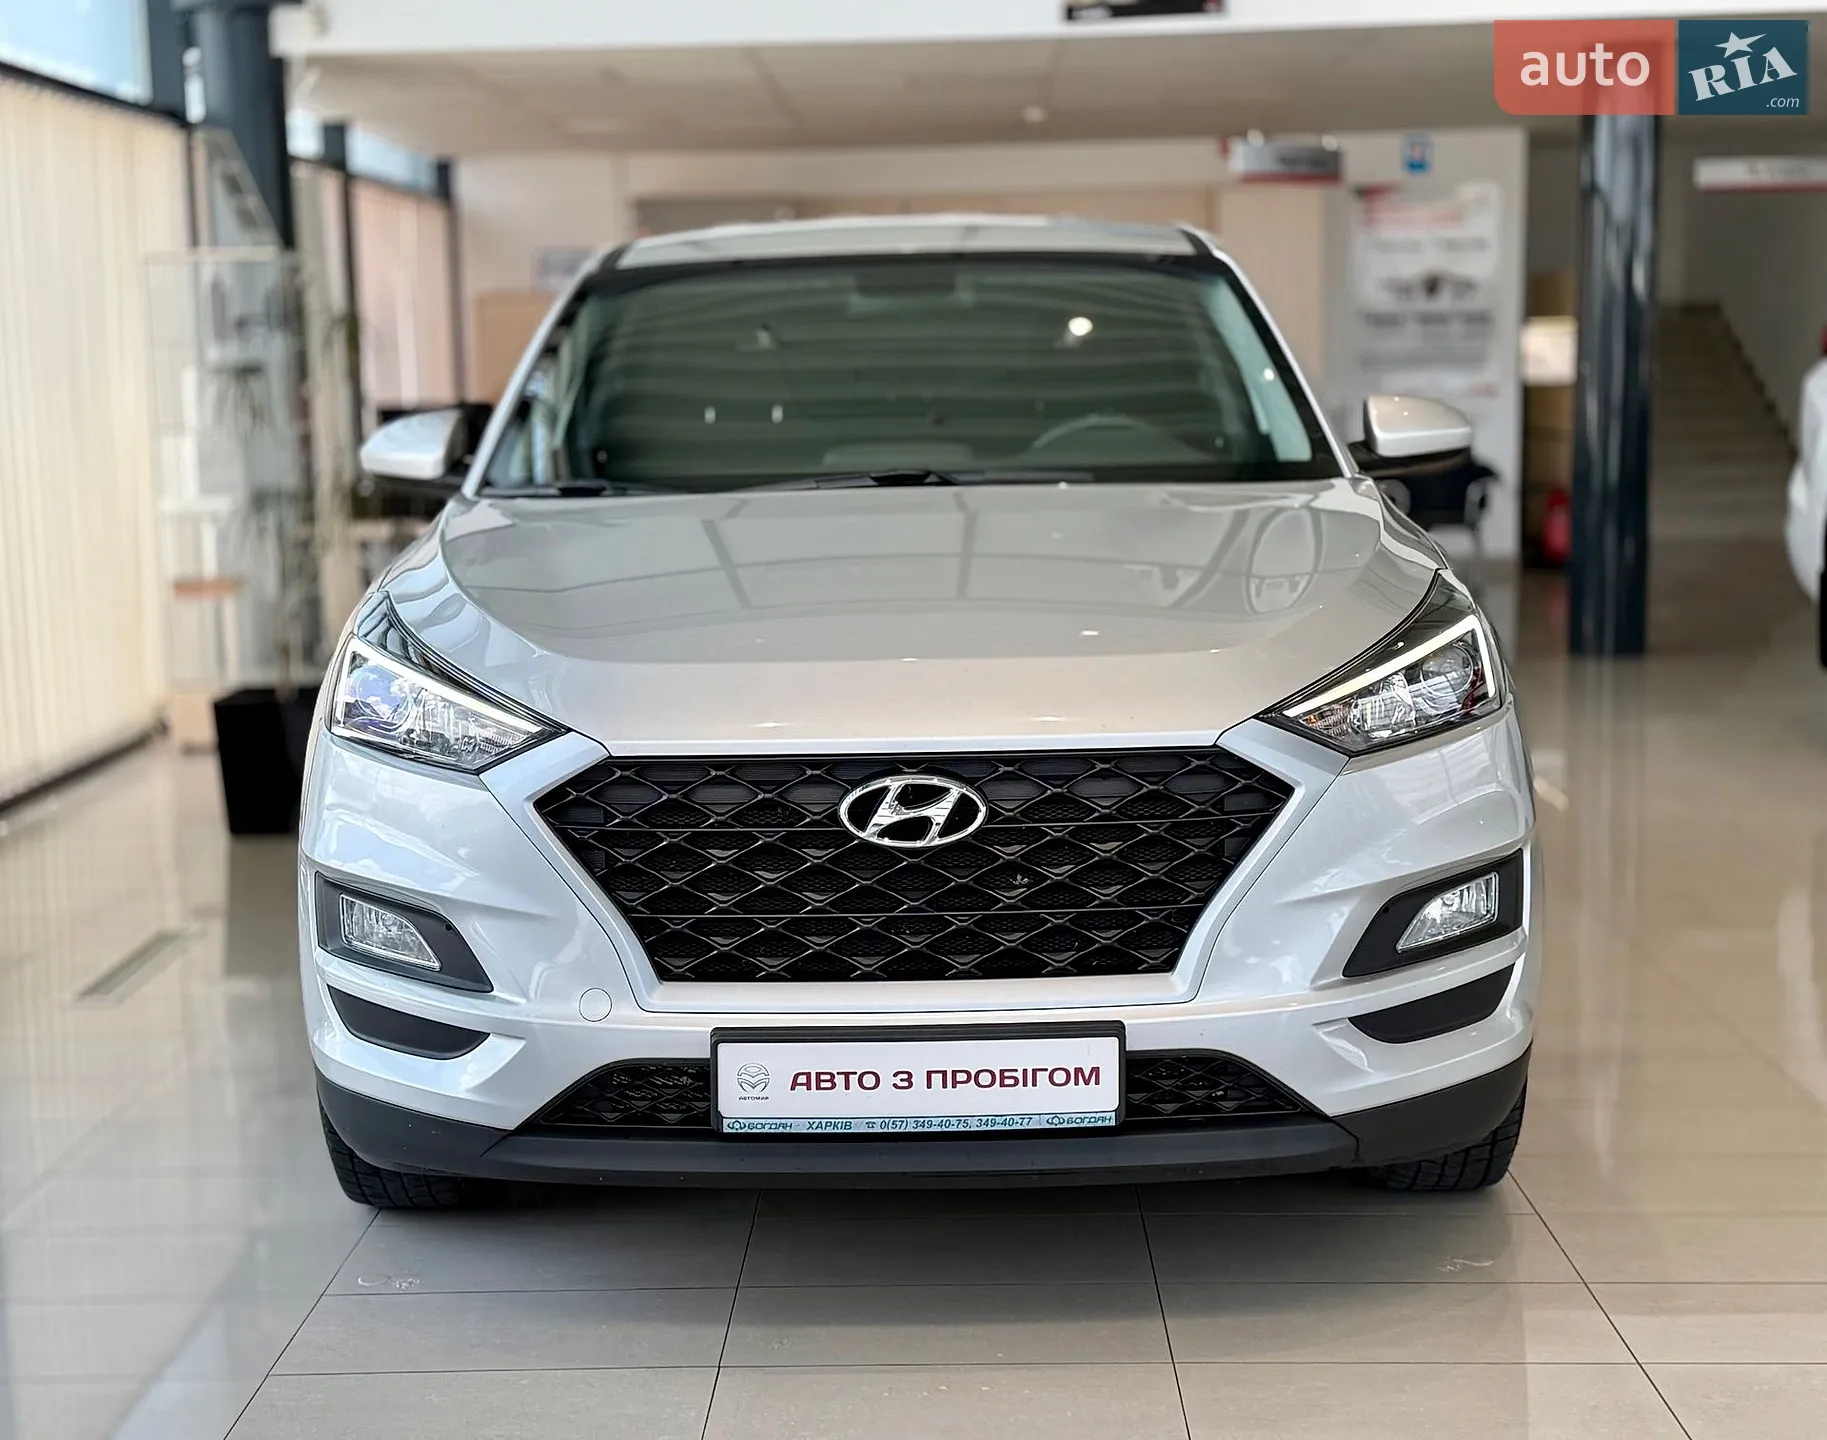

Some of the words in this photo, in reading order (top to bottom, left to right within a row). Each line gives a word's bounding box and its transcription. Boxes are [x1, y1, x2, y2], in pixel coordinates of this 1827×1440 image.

[789, 1071, 881, 1091] АВТО
[926, 1066, 1101, 1090] ПРОБІГОМ
[747, 1122, 793, 1130] БОГДАН
[806, 1120, 853, 1130] ХАРКІВ
[879, 1119, 908, 1131] 0(57)
[912, 1118, 972, 1130] 349-40-75,
[976, 1117, 1033, 1129] 349-40-77
[1066, 1115, 1113, 1126] БОГДАН
